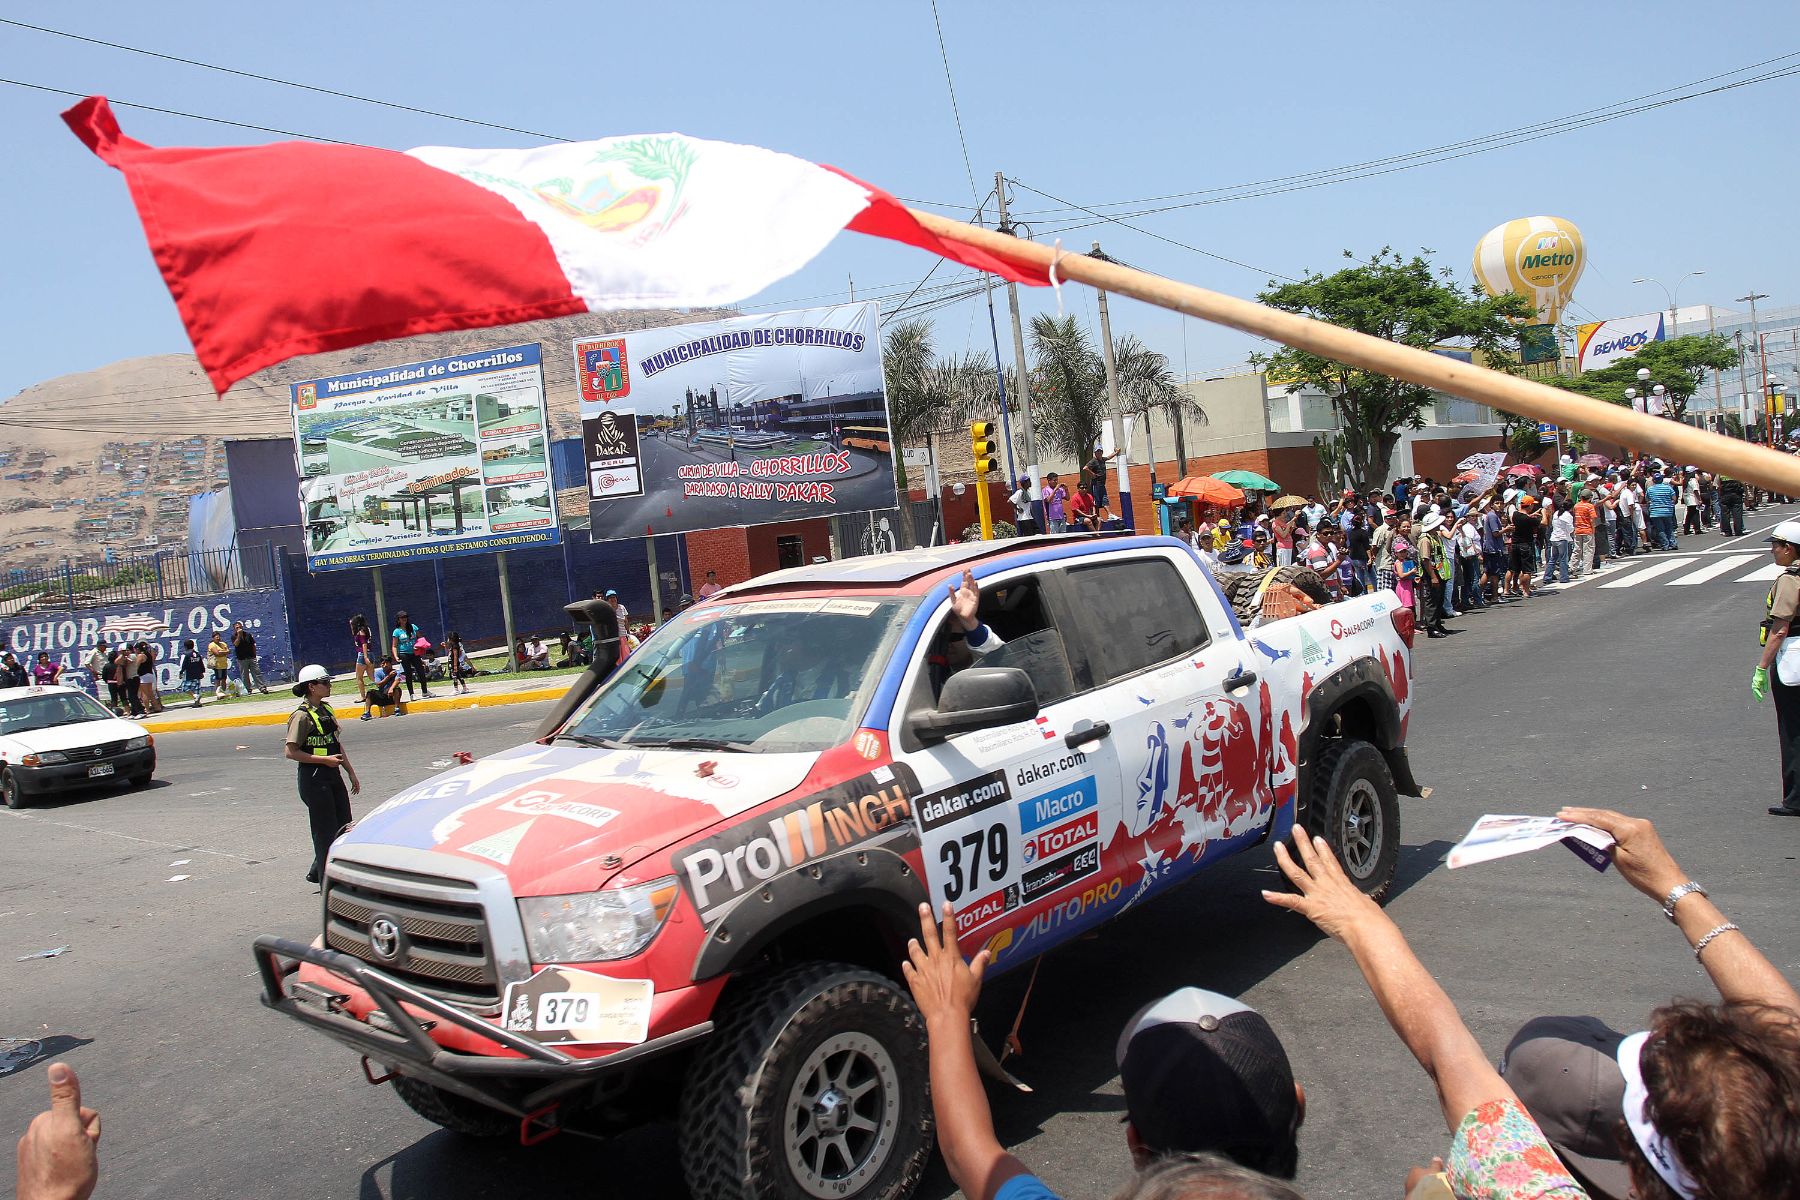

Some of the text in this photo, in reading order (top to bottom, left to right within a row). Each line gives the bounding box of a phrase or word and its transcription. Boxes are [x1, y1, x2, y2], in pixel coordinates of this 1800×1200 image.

[1522, 253, 1574, 269] Metro
[640, 328, 865, 376] MUNICIPALIDAD DE CHORRILLOS
[1593, 330, 1648, 356] BEMBOS
[328, 352, 523, 392] Municipalidad de Chorrillos
[333, 399, 366, 410] Parque
[369, 391, 412, 404] Navidad
[429, 384, 459, 394] Villa
[595, 441, 629, 456] DAKAR
[678, 464, 701, 479] CURVA
[701, 464, 714, 478] DE
[714, 461, 739, 478] VILLA
[750, 449, 851, 477] CHORRILLOS
[705, 482, 727, 497] PASO
[728, 481, 738, 498] A
[738, 482, 774, 500] RALLY
[776, 482, 836, 504] DAKAR
[314, 558, 328, 567] HAY
[329, 556, 344, 565] MAS
[344, 555, 365, 564] OBRAS
[366, 550, 410, 561] TERMINADAS
[416, 546, 439, 555] OTRAS
[440, 544, 455, 553] QUE
[455, 540, 488, 551] ESTAMOS
[349, 537, 383, 546] Complejo
[1343, 617, 1375, 638] SALFACORP
[1017, 752, 1087, 786] dakar.com
[922, 779, 1006, 822] dakar.com
[1035, 791, 1084, 822] Macro
[1039, 821, 1097, 853] TOTAL
[940, 822, 1008, 902] 379
[956, 900, 1002, 931] TOTAL
[1004, 877, 1122, 958] AUTOPRO
[546, 998, 589, 1024] 379
